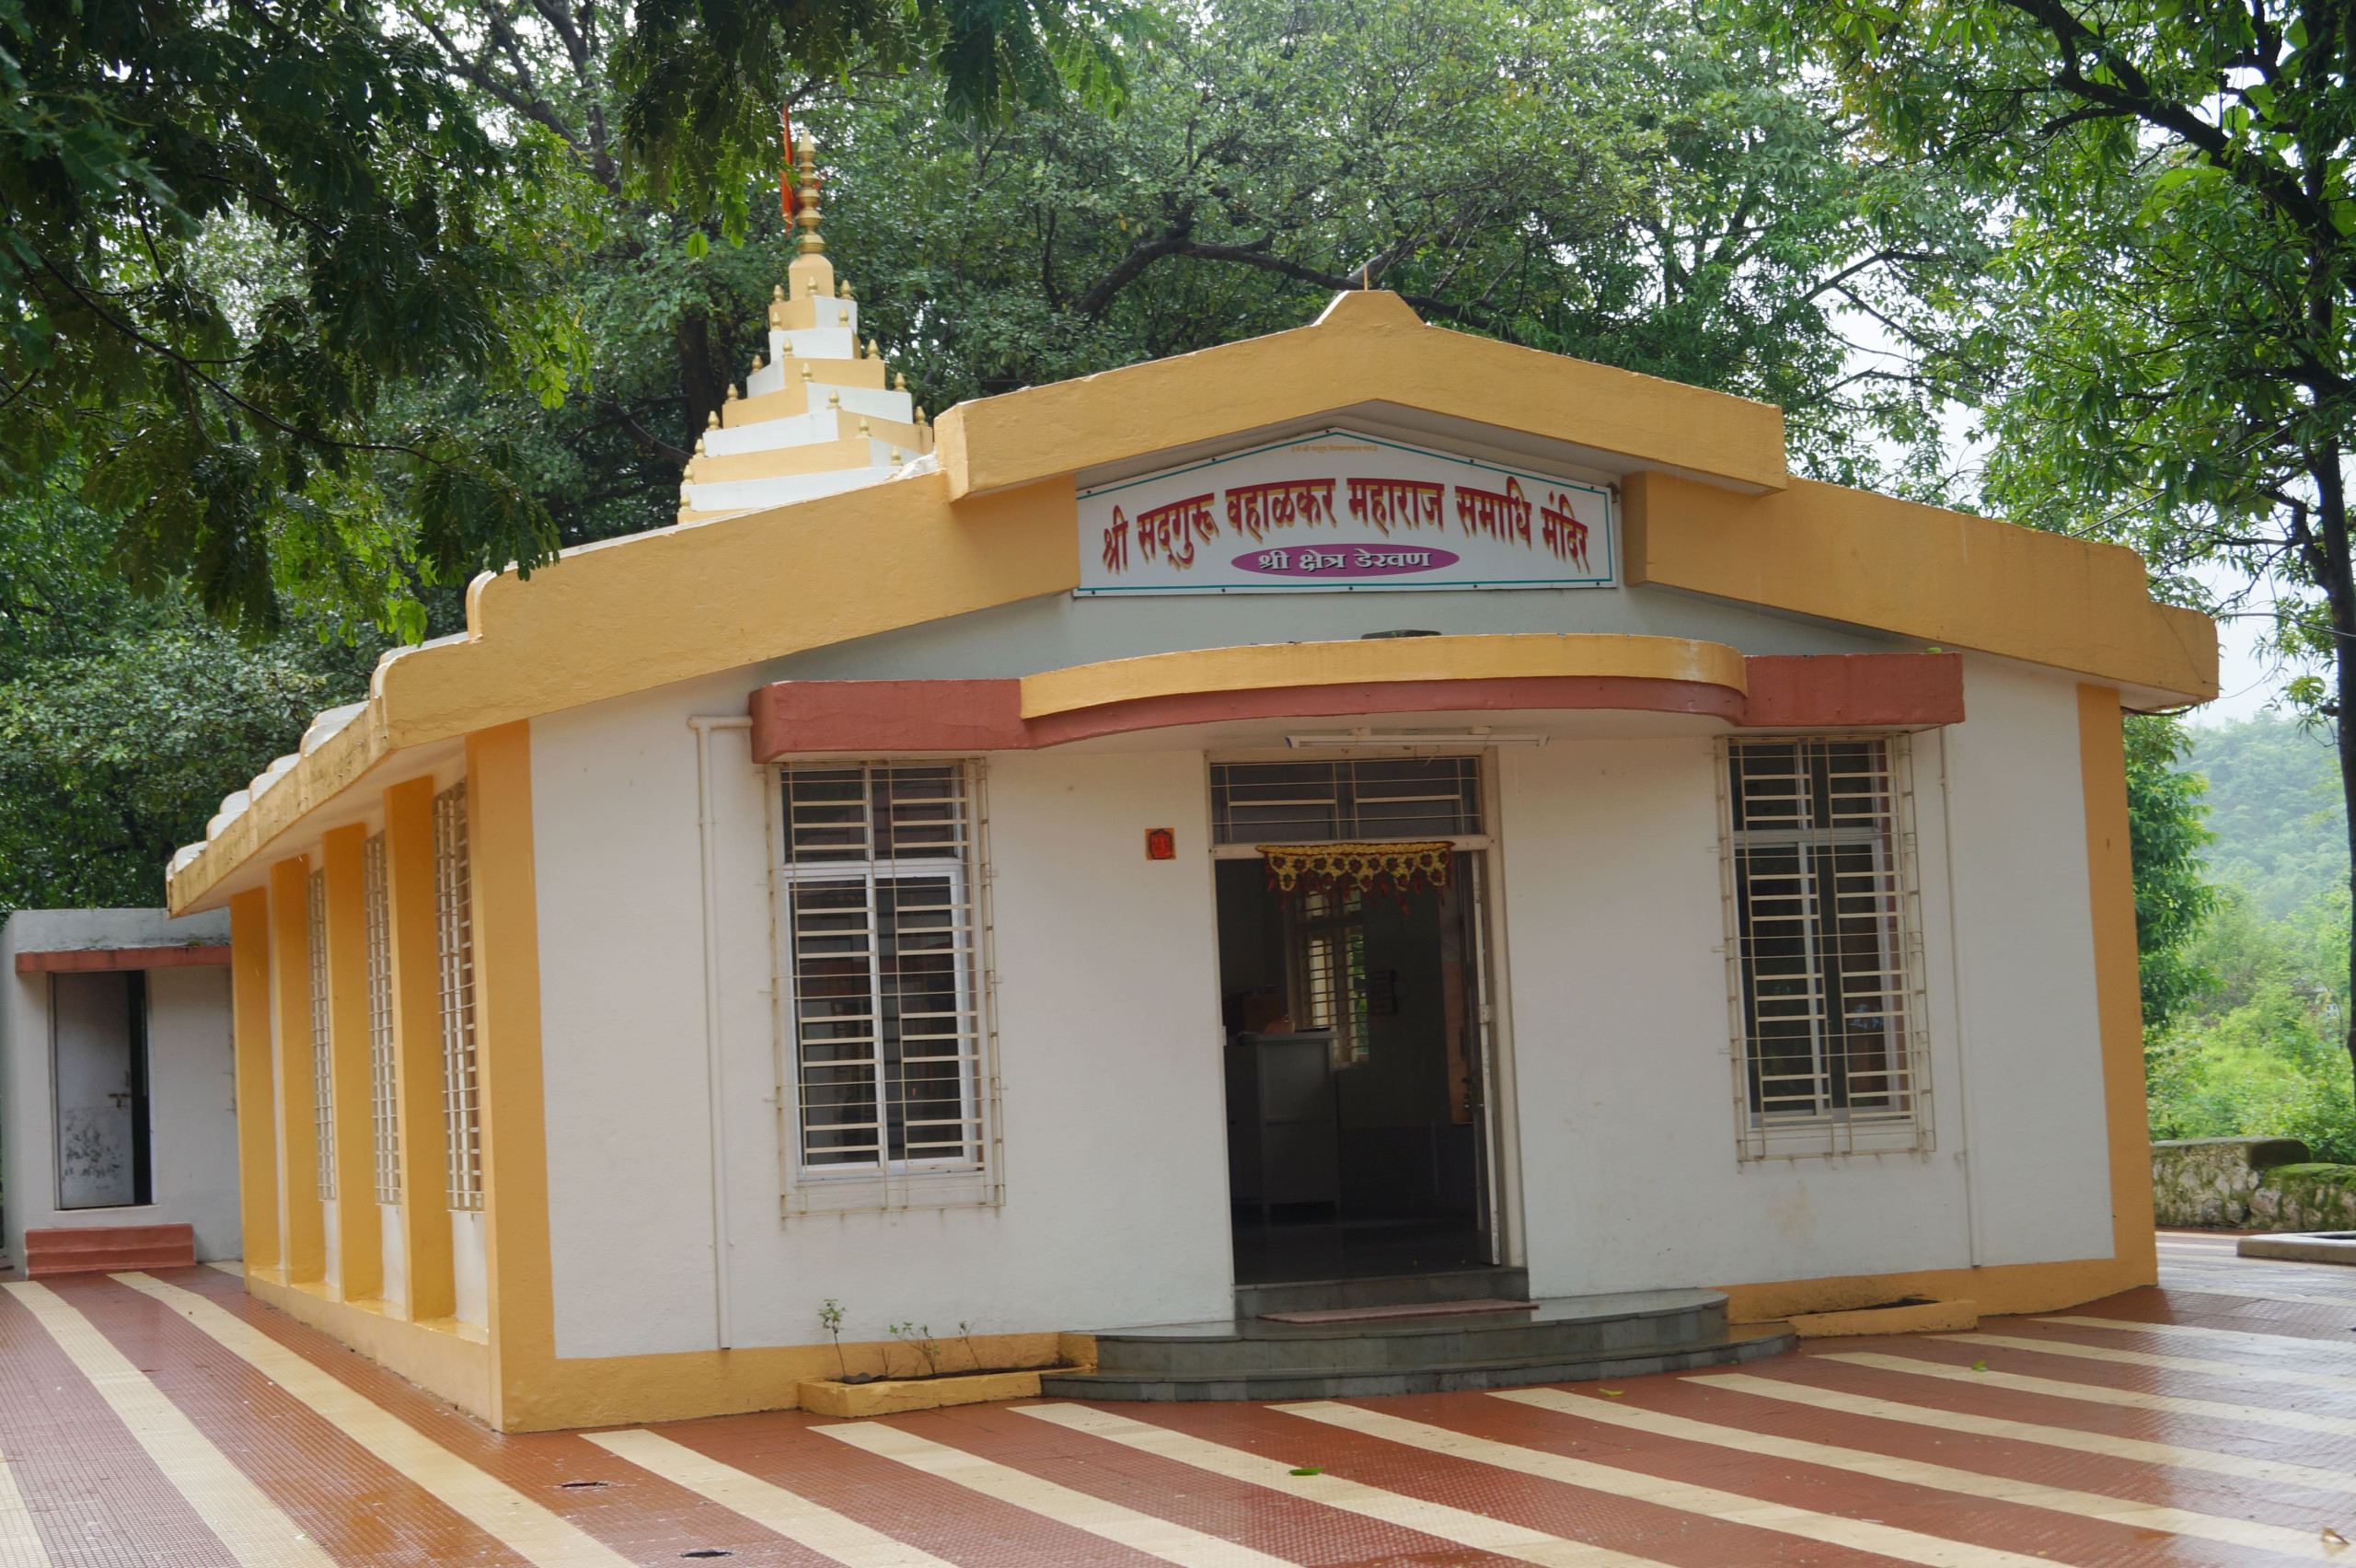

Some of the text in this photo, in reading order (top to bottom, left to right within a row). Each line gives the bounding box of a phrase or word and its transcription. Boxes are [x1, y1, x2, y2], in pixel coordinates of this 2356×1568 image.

[1103, 504, 1128, 575] श्री
[1225, 478, 1337, 545] वहाळकर
[1346, 478, 1445, 538] महाराज
[1455, 475, 1532, 551] समाधि
[1540, 490, 1591, 575] मंदिर
[1258, 548, 1432, 572] श्री क्षेत्र डेरवण
